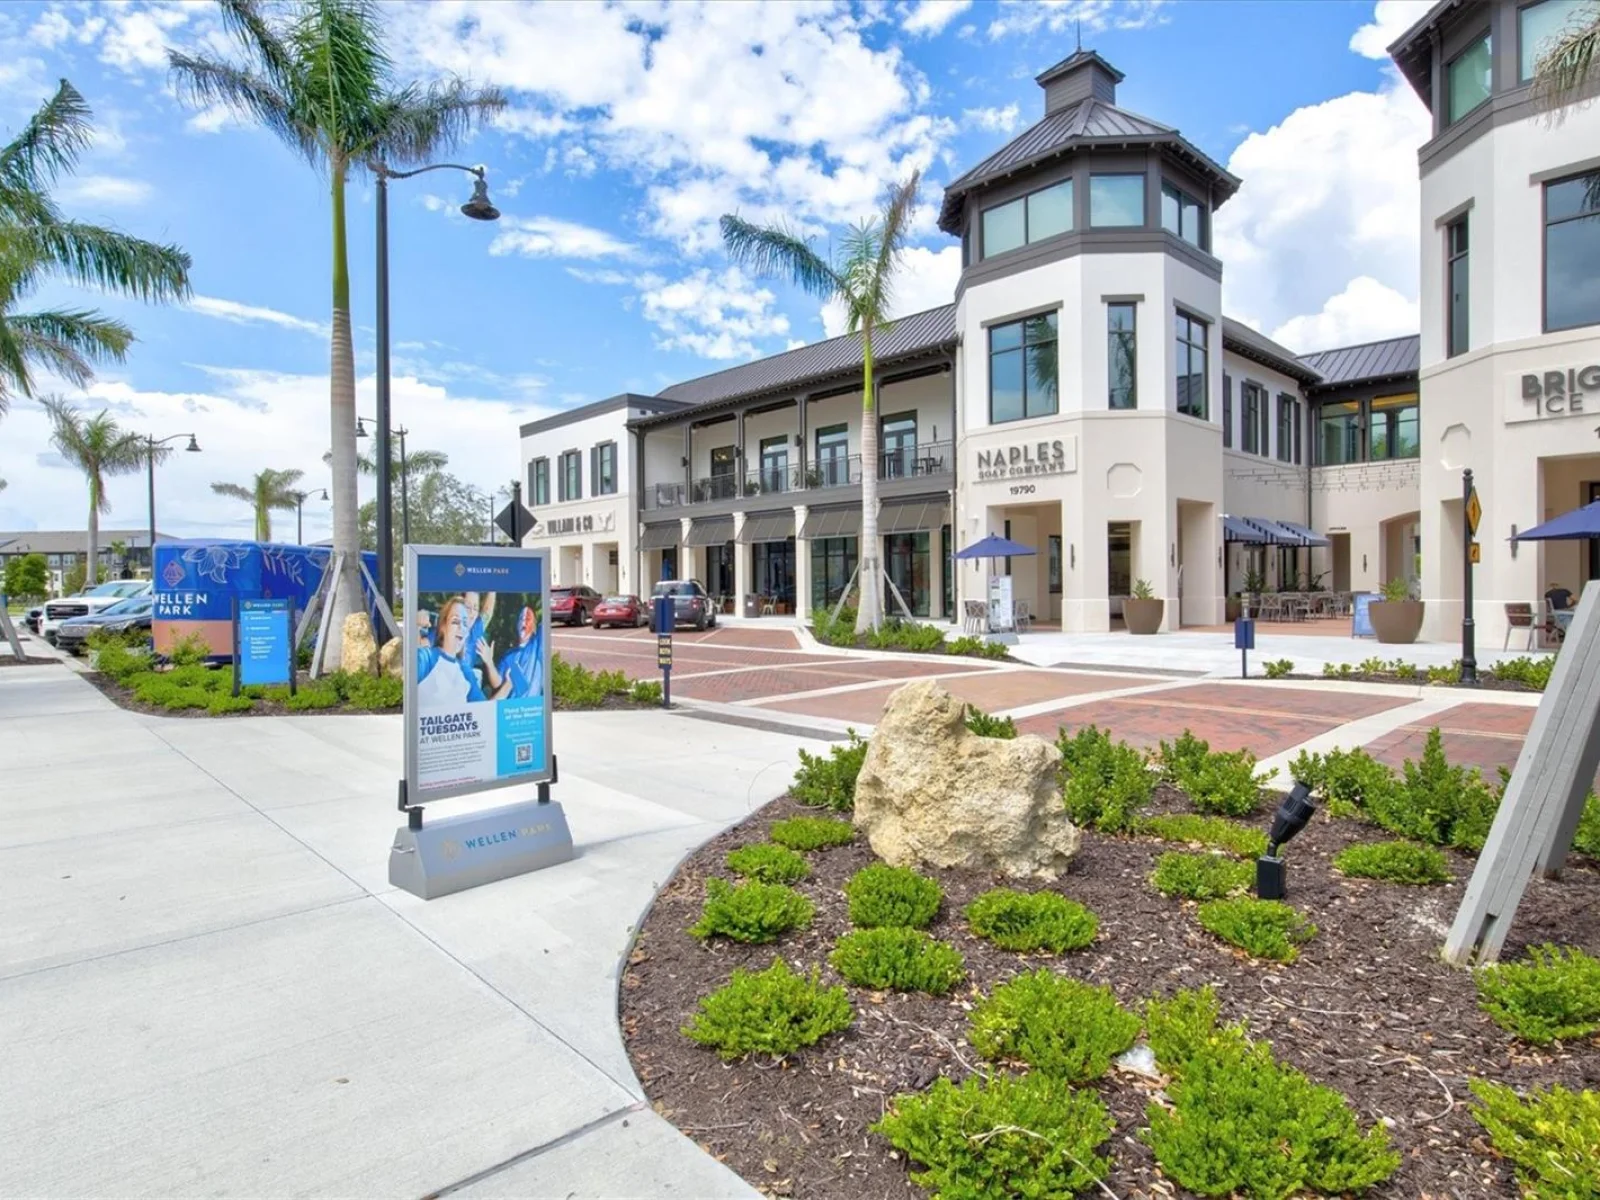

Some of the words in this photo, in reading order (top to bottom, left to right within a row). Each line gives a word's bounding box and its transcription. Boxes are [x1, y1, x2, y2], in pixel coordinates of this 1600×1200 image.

[1521, 365, 1600, 399] BRIG
[1536, 393, 1583, 415] ICE
[977, 440, 1064, 468] NAPLES
[978, 469, 1006, 480] SOAP
[1009, 461, 1065, 476] COMPANY
[1009, 484, 1036, 495] 19790
[159, 605, 192, 616] PARK
[420, 712, 472, 726] TAILGATE
[420, 721, 478, 736] TUESDAYS
[420, 736, 430, 744] AT
[431, 733, 462, 743] WELLEN
[463, 731, 481, 740] PARK
[465, 829, 517, 849] WELLEN
